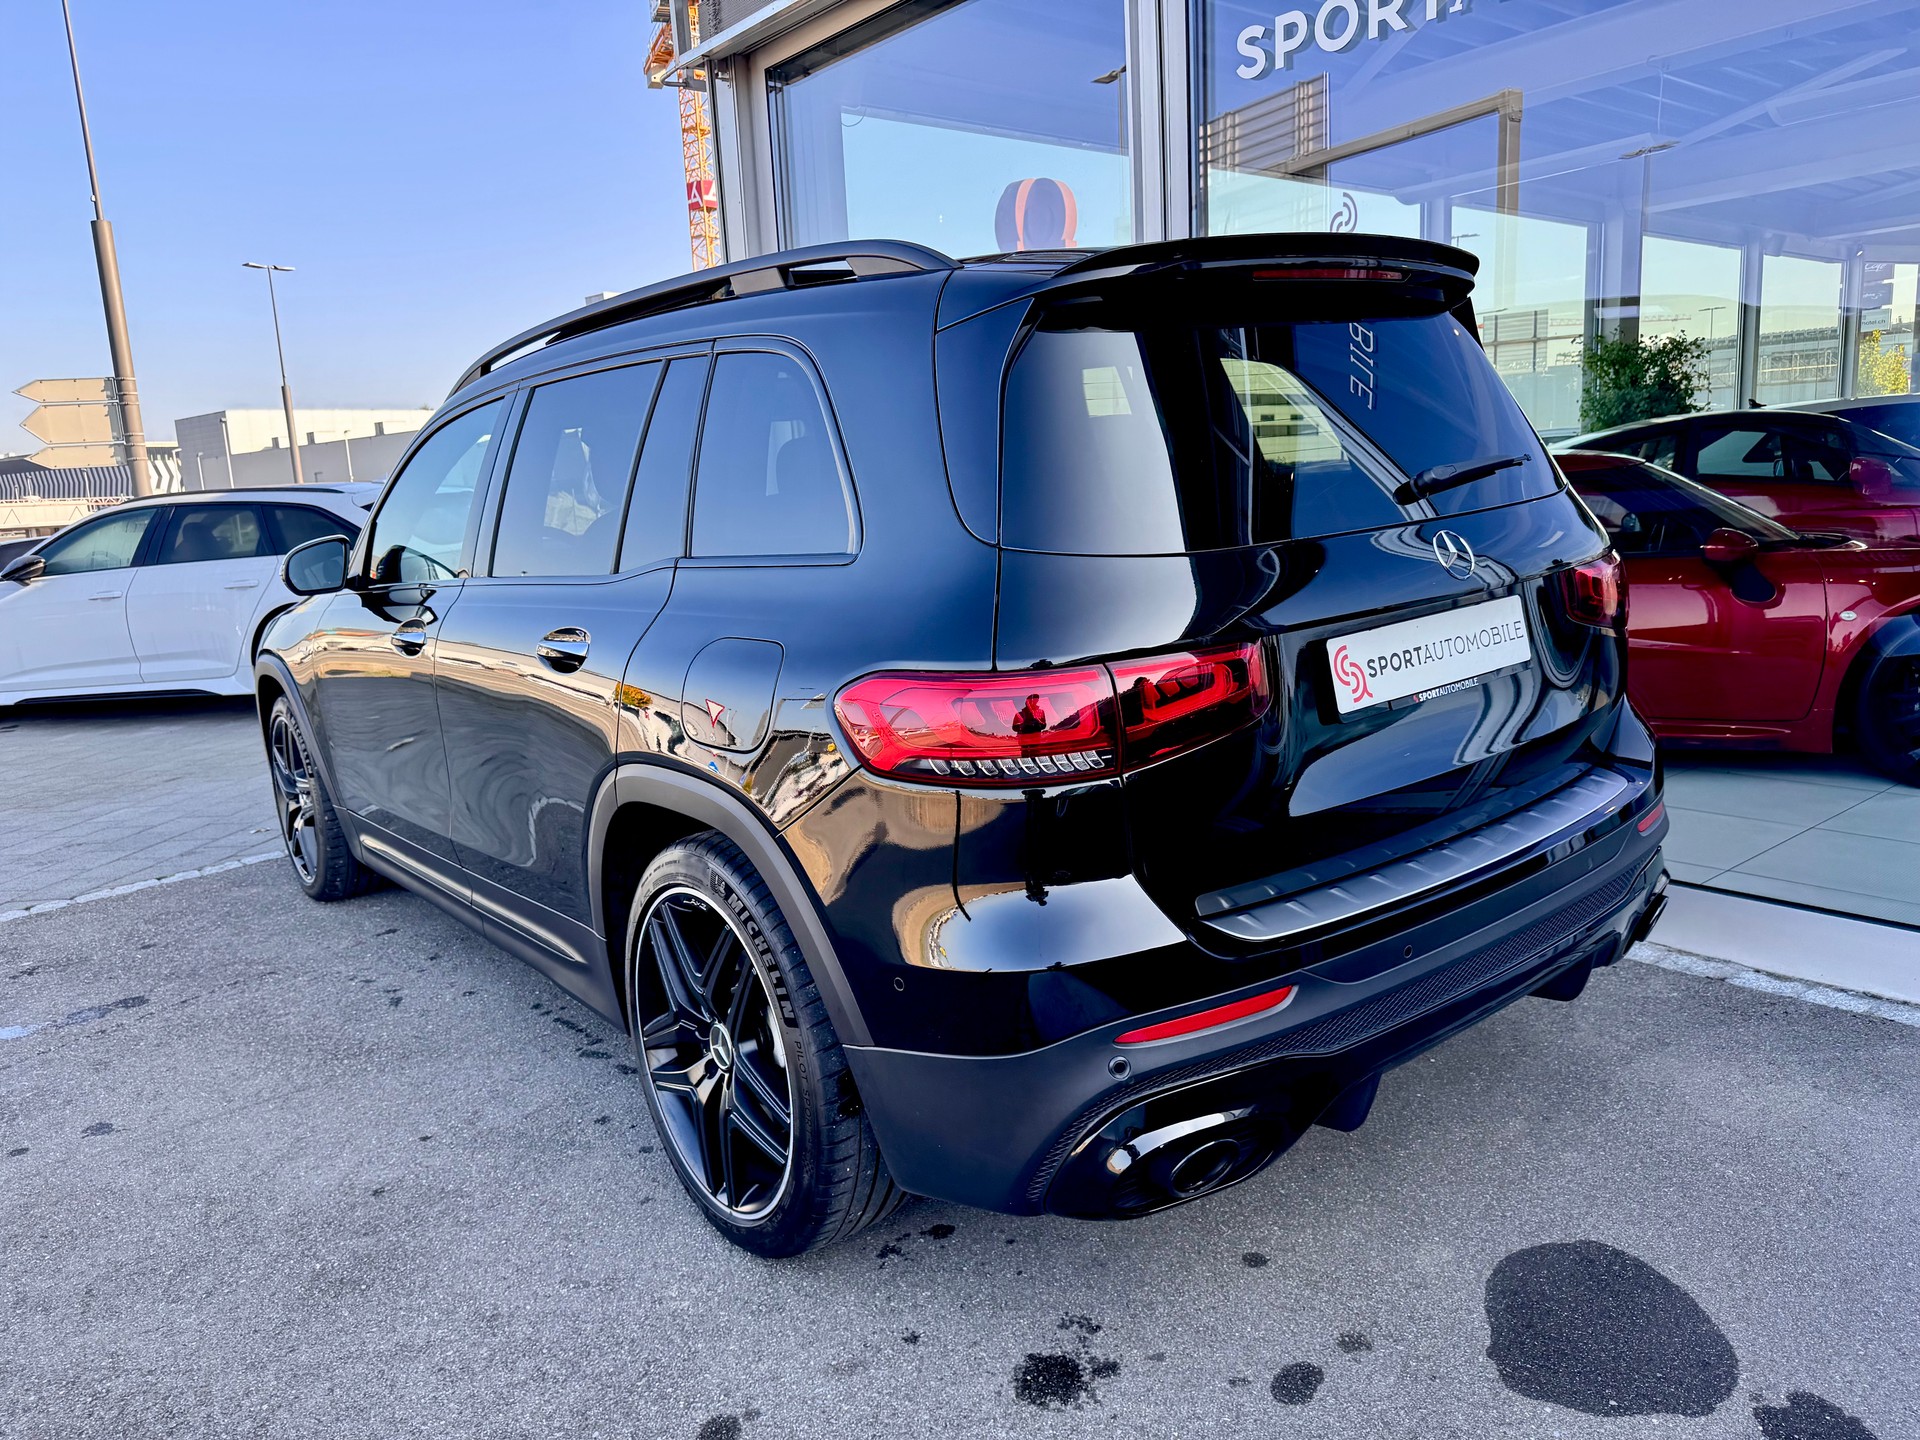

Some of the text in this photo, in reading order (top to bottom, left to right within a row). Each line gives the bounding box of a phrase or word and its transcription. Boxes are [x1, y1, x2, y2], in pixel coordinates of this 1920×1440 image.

[1236, 0, 1463, 79] SPOR
[1366, 620, 1524, 678] SPORTAUTOMOBILE
[1418, 677, 1479, 702] SPORTAUTOMOBILE
[728, 893, 795, 1019] MICHELIN
[794, 1040, 809, 1084] PILOT
